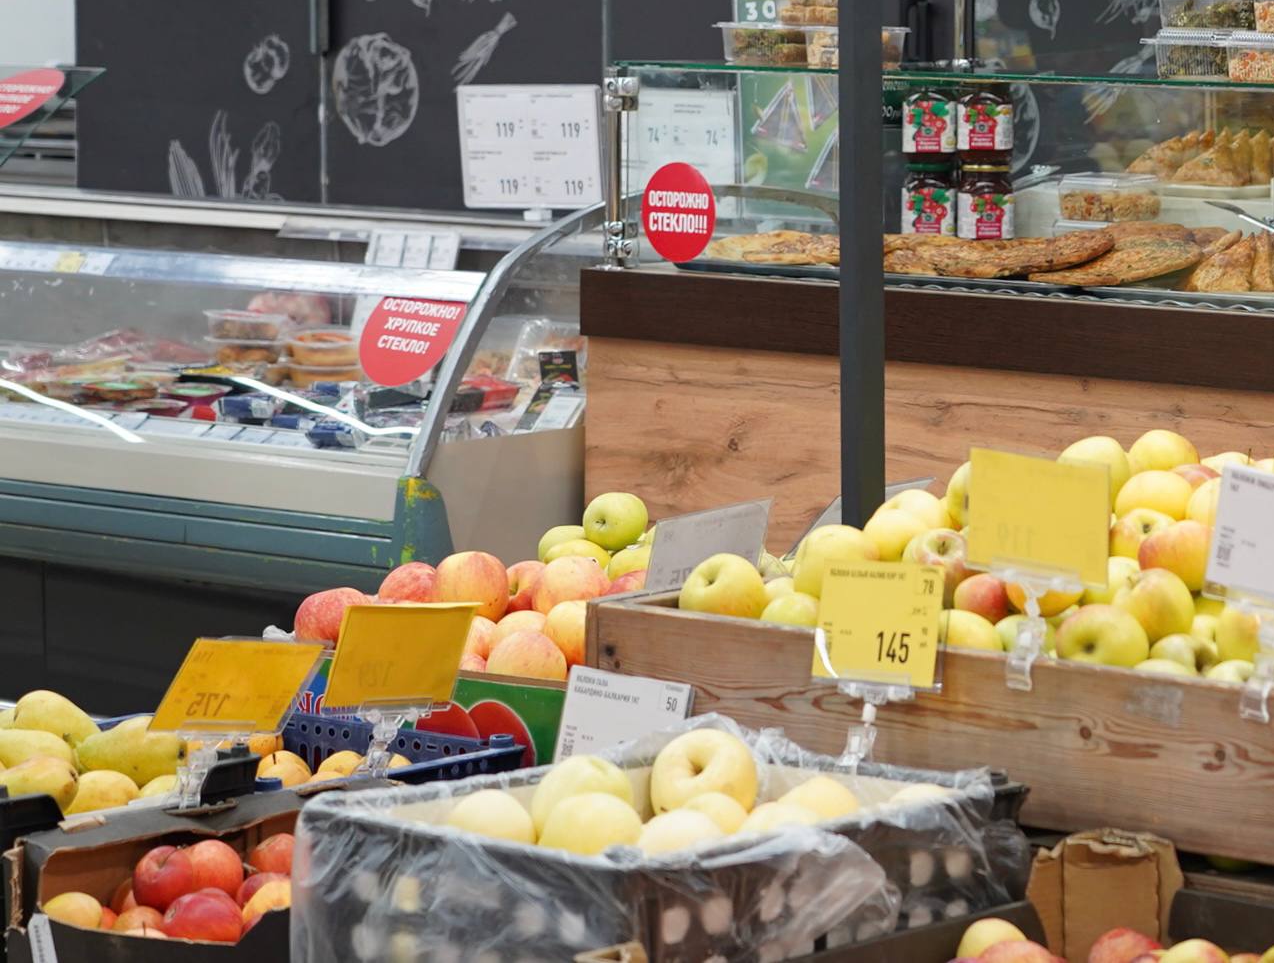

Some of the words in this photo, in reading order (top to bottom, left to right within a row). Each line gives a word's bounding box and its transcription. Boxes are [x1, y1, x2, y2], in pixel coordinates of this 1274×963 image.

[496, 122, 515, 138] 119
[561, 122, 581, 138] 119
[500, 179, 519, 195] 119
[565, 180, 584, 195] 119
[648, 190, 709, 210] ОСТОРОЖНО
[649, 212, 708, 234] СТЕКЛО!!!
[383, 298, 461, 320] ОСТОРОЖНО!
[384, 316, 441, 337] ХРУПКОЕ
[377, 335, 430, 354] СТЕКЛО!
[923, 579, 935, 595] 78
[876, 631, 911, 664] 145
[665, 696, 677, 712] 50
